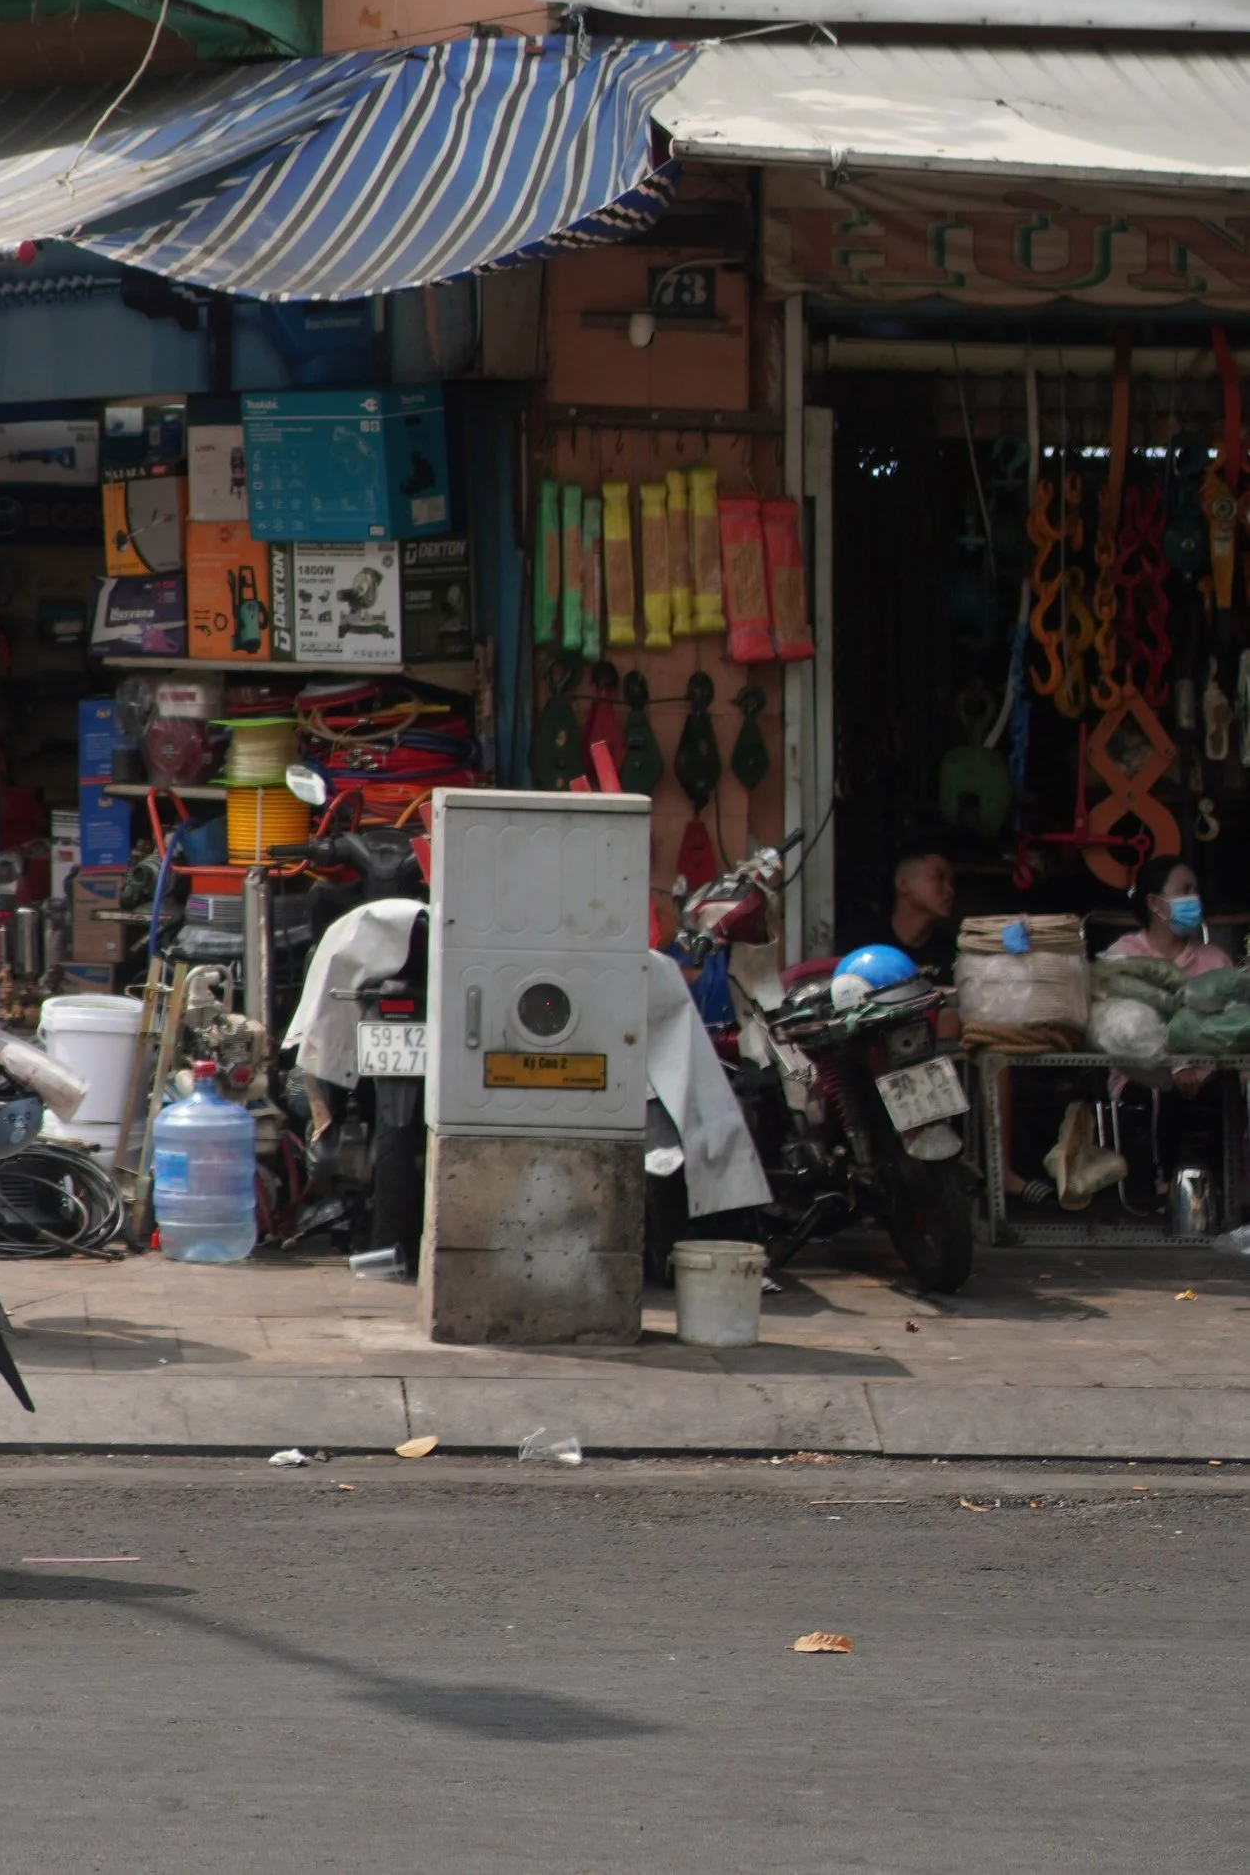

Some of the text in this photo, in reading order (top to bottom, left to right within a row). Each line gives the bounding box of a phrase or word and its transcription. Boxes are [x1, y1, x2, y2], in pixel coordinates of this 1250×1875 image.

[655, 273, 707, 305] 73
[27, 500, 97, 531] BOS
[371, 1027, 426, 1048] 59-K2
[364, 1051, 427, 1073] 492.7
